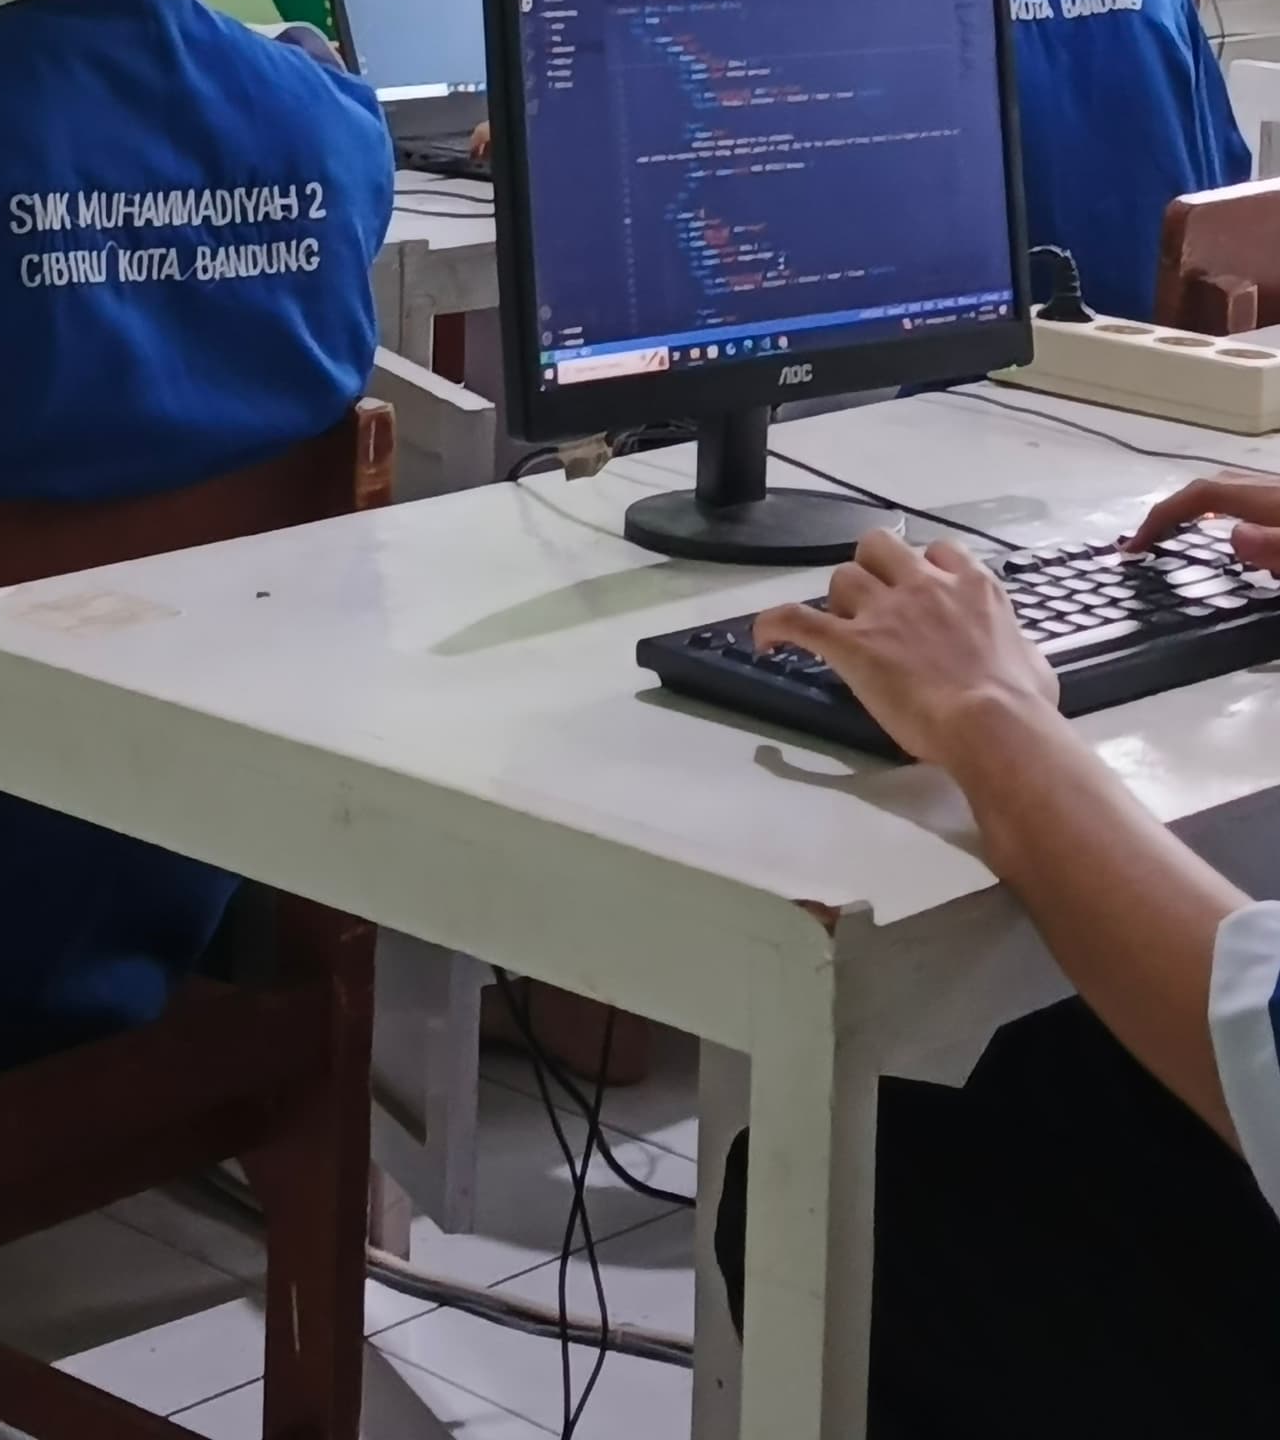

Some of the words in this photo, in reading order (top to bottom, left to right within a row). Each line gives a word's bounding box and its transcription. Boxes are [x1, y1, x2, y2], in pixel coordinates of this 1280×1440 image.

[9, 192, 71, 234] SMK
[78, 184, 298, 231] MUHAMMADIYAH
[305, 182, 327, 220] 2
[20, 250, 108, 288] CIBIRU
[118, 247, 187, 283] KOTA
[196, 238, 321, 281] BANDUNG
[778, 363, 813, 386] AOC
